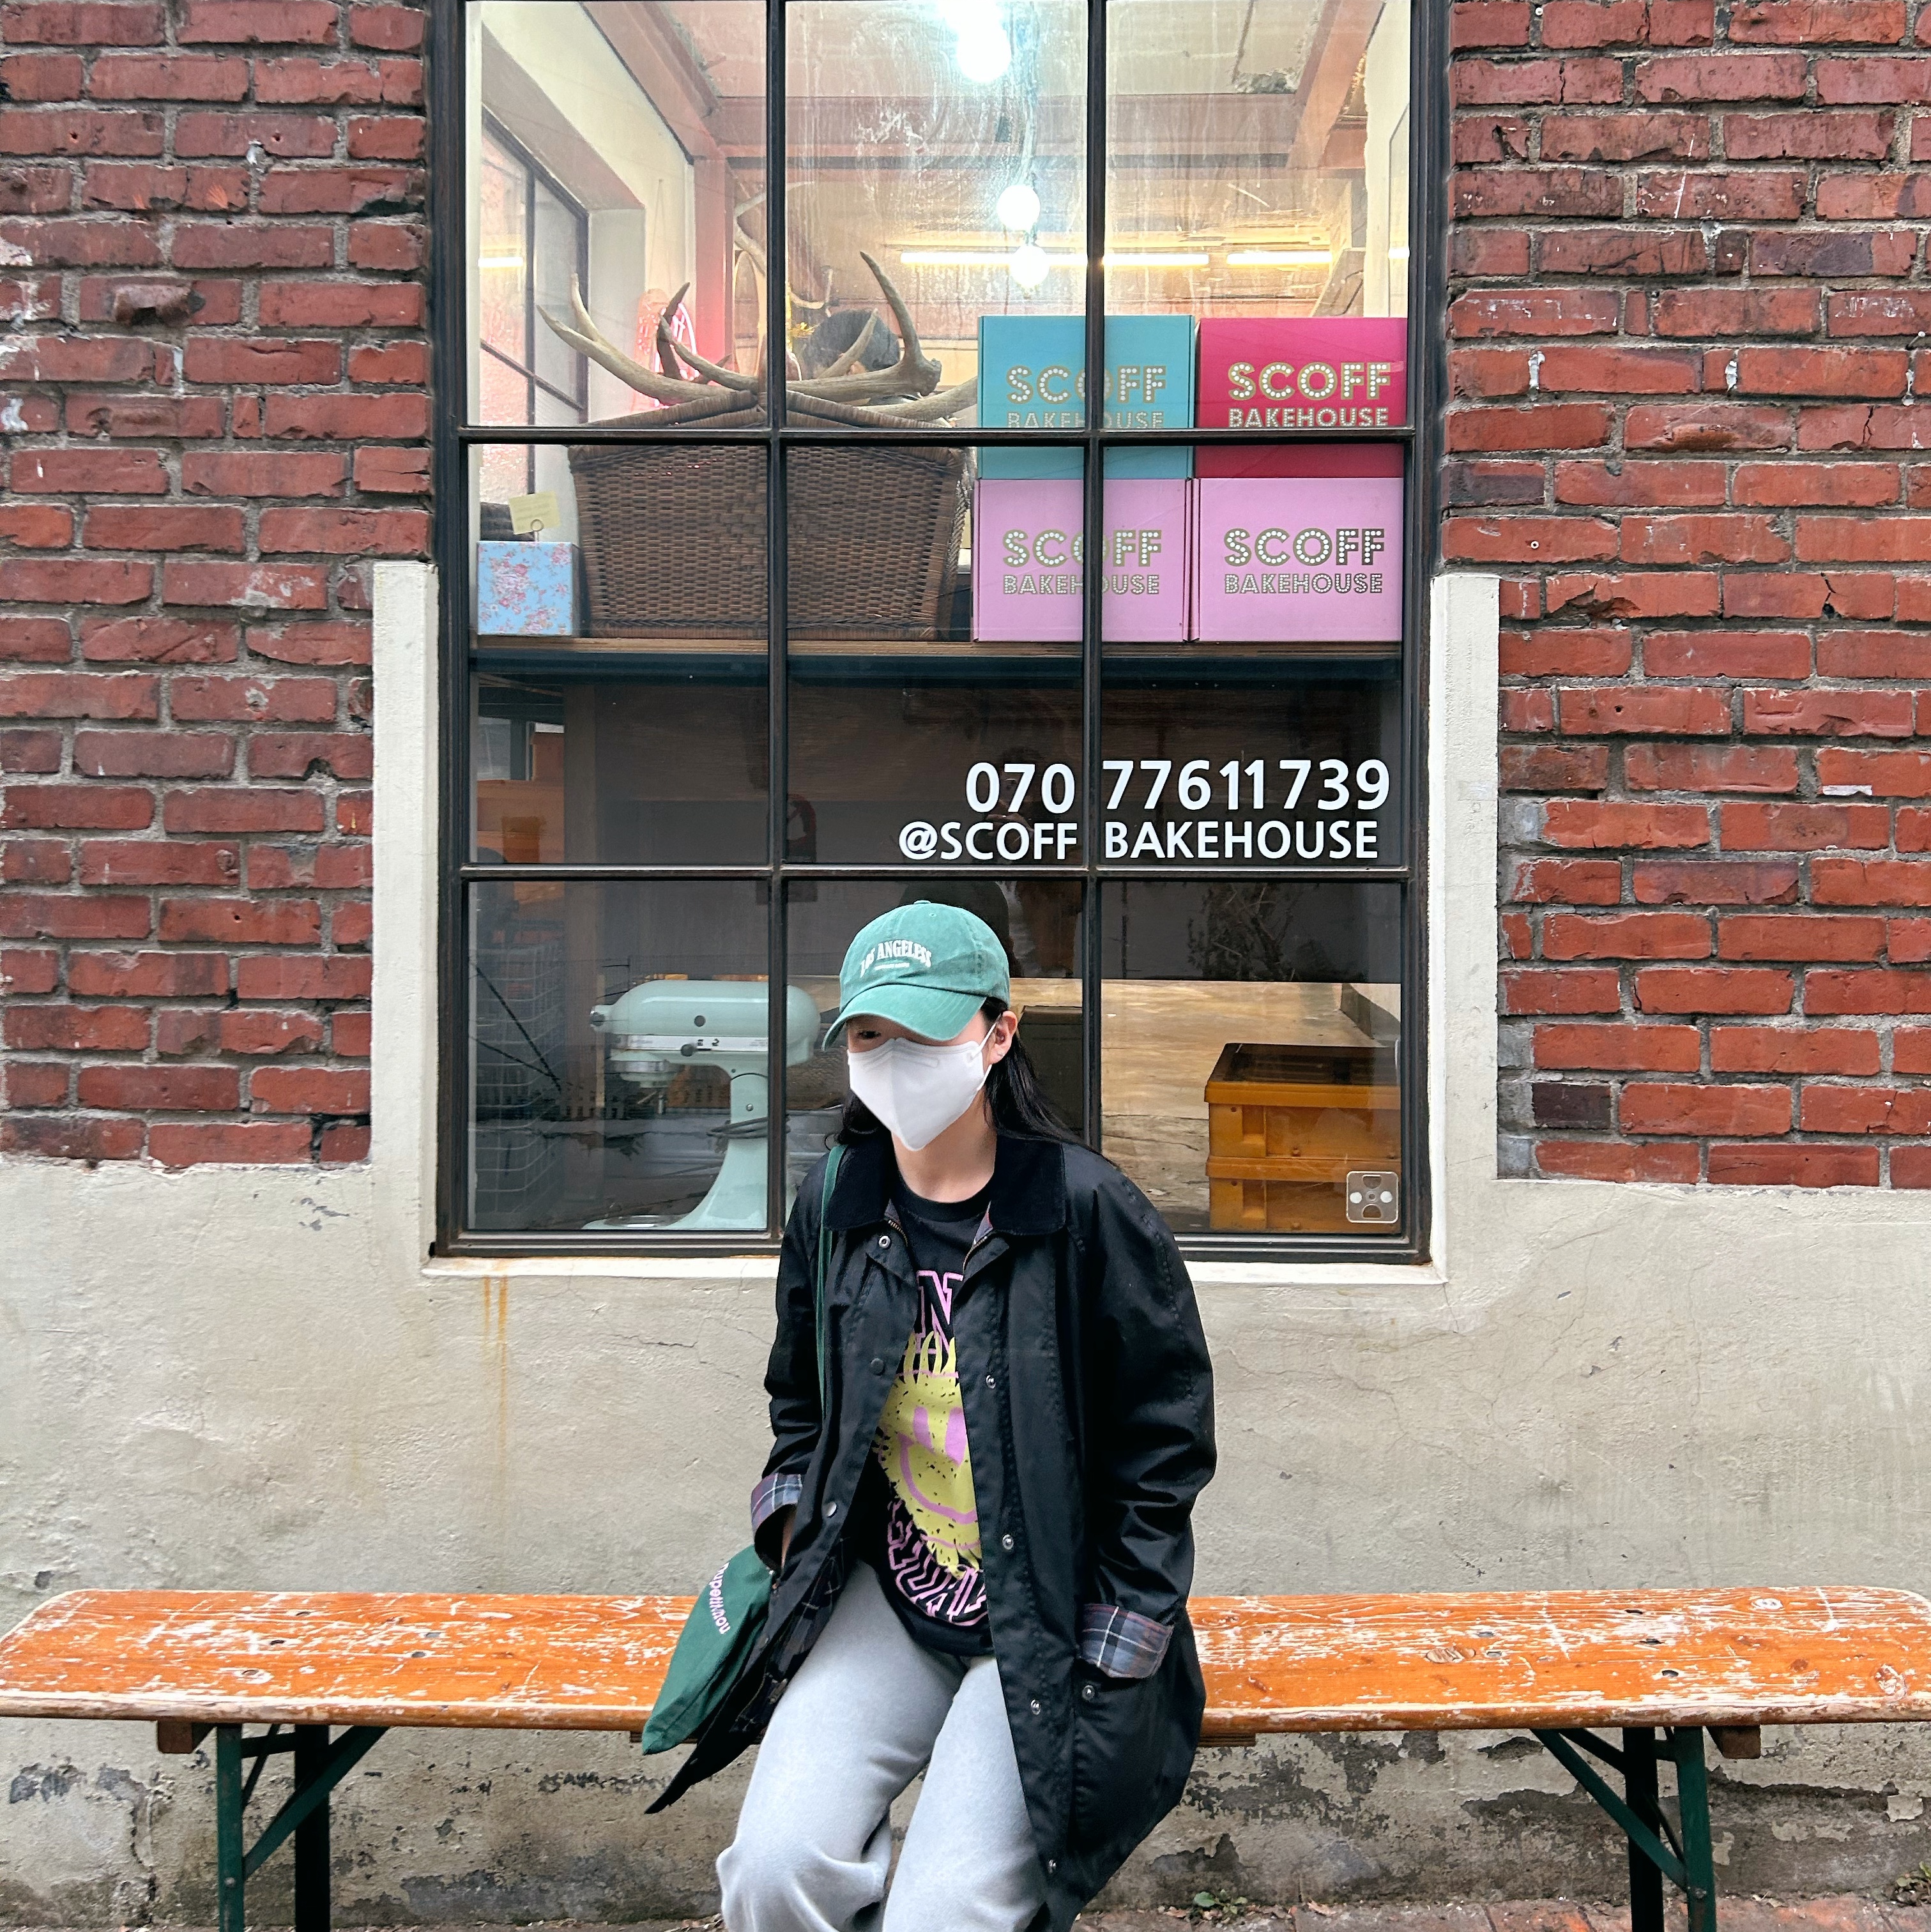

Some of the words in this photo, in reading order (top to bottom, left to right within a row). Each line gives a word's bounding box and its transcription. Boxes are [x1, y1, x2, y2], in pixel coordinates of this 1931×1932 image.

[1228, 361, 1391, 401] SCOFF
[1228, 407, 1389, 428] BAKEHOUSE
[1224, 528, 1385, 567] SCOFF
[1225, 573, 1383, 594] BAKEHOUSE
[966, 762, 1075, 814] 070
[1103, 759, 1389, 810] 77611739
[899, 821, 1078, 860] @SCOFF
[1105, 820, 1378, 859] BAKEHOUSE
